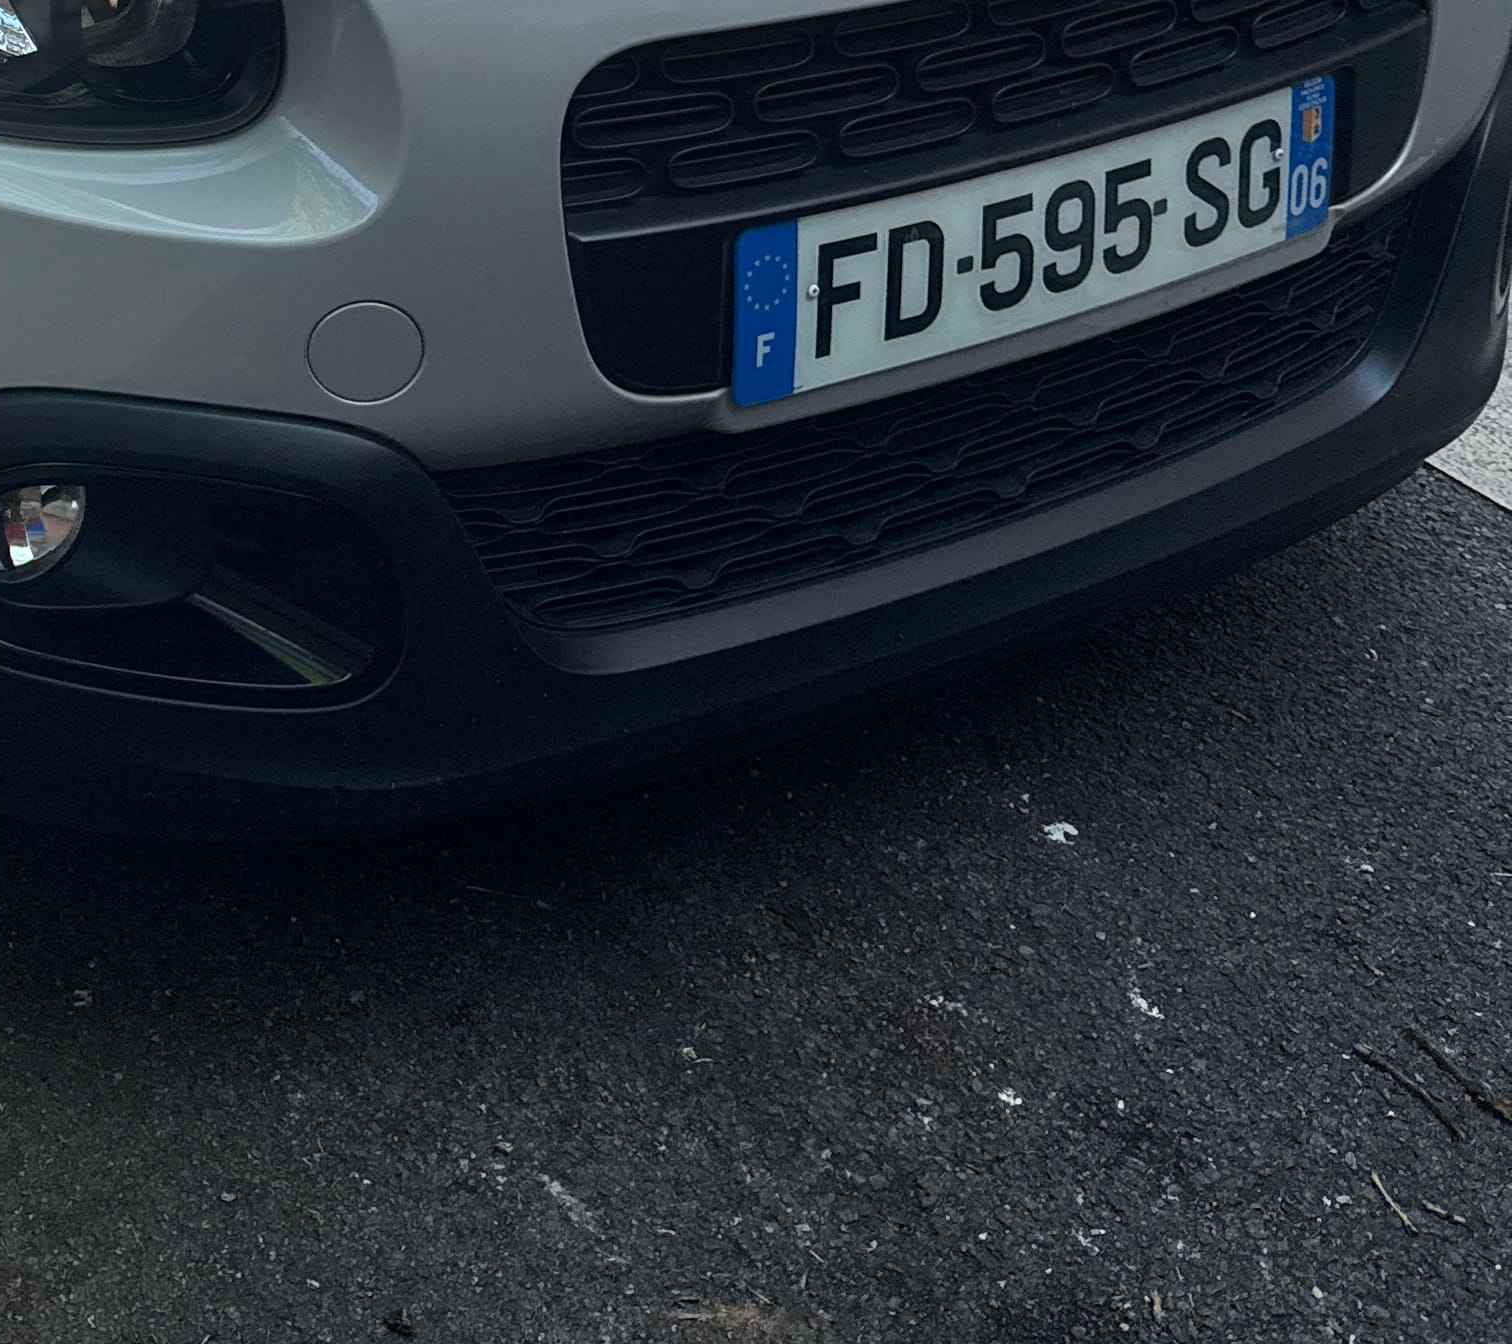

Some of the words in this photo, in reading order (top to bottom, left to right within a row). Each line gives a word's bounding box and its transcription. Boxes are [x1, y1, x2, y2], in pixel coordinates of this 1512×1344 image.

[1290, 156, 1328, 216] 06
[814, 118, 1283, 360] FD-595-SG
[755, 331, 775, 368] F
